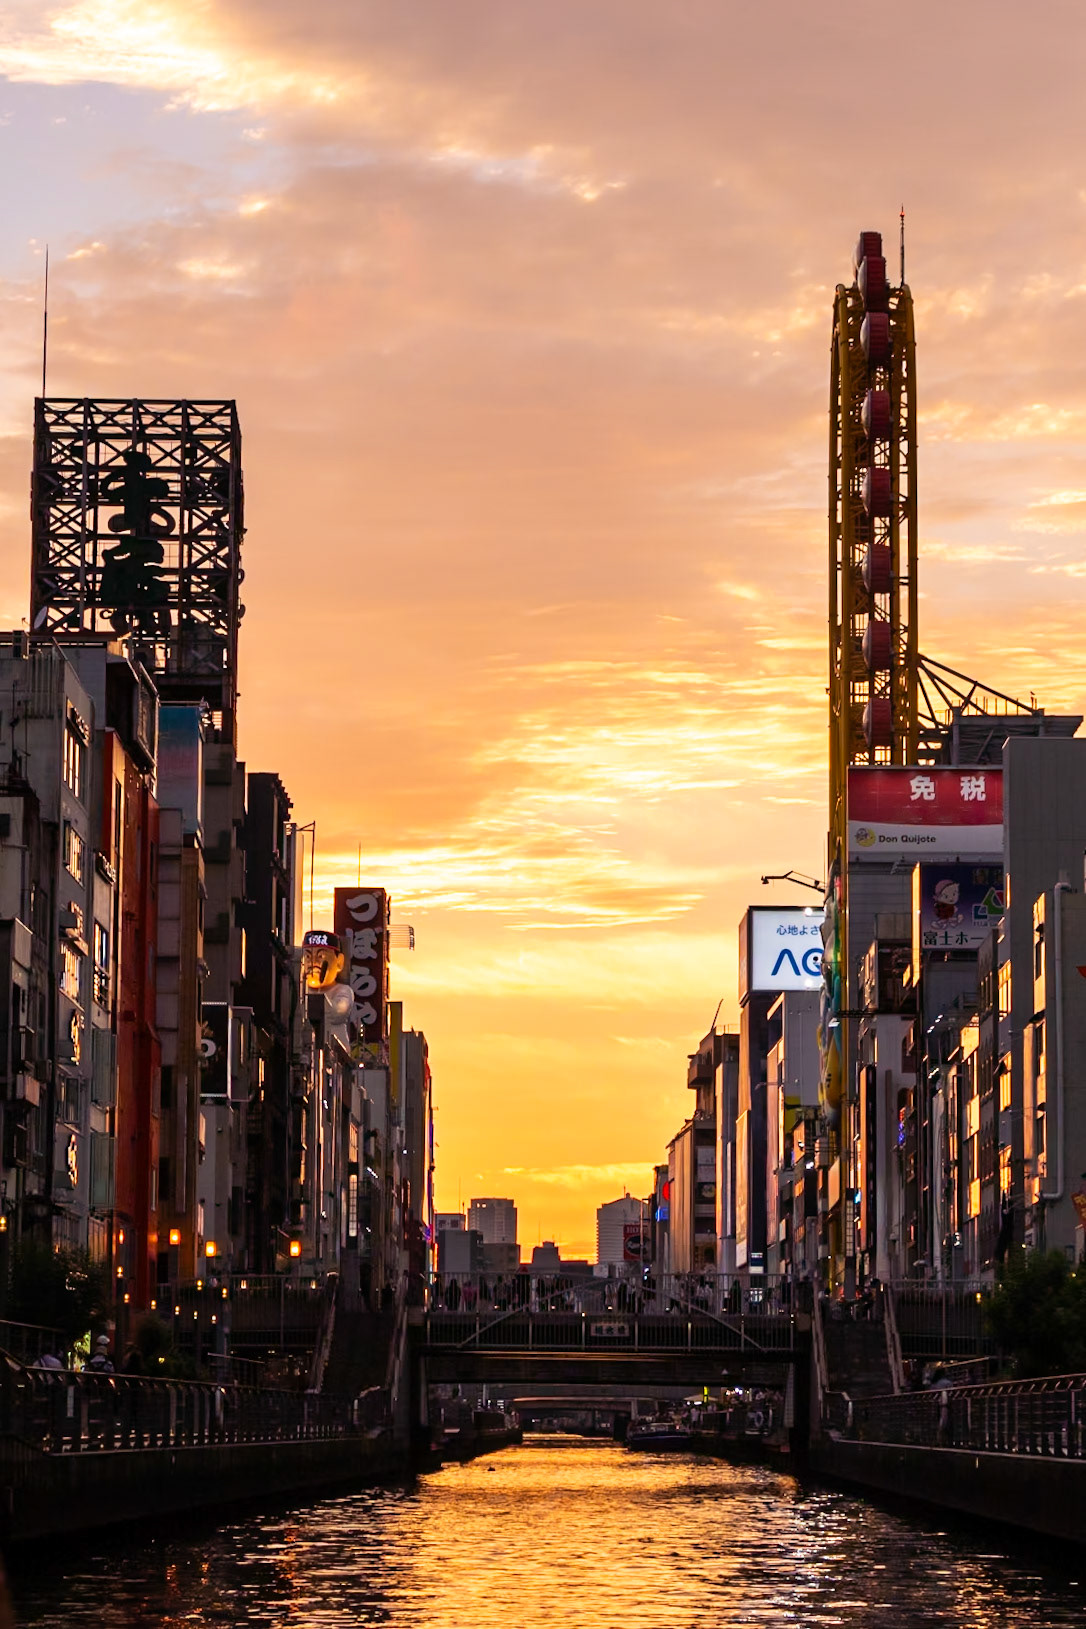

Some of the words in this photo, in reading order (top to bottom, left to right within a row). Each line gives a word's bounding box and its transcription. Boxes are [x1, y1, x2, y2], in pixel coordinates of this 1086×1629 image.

[909, 775, 986, 801] 免税
[878, 834, 898, 843] Don
[901, 834, 936, 845] Quijote
[776, 924, 819, 936] 心地よさ
